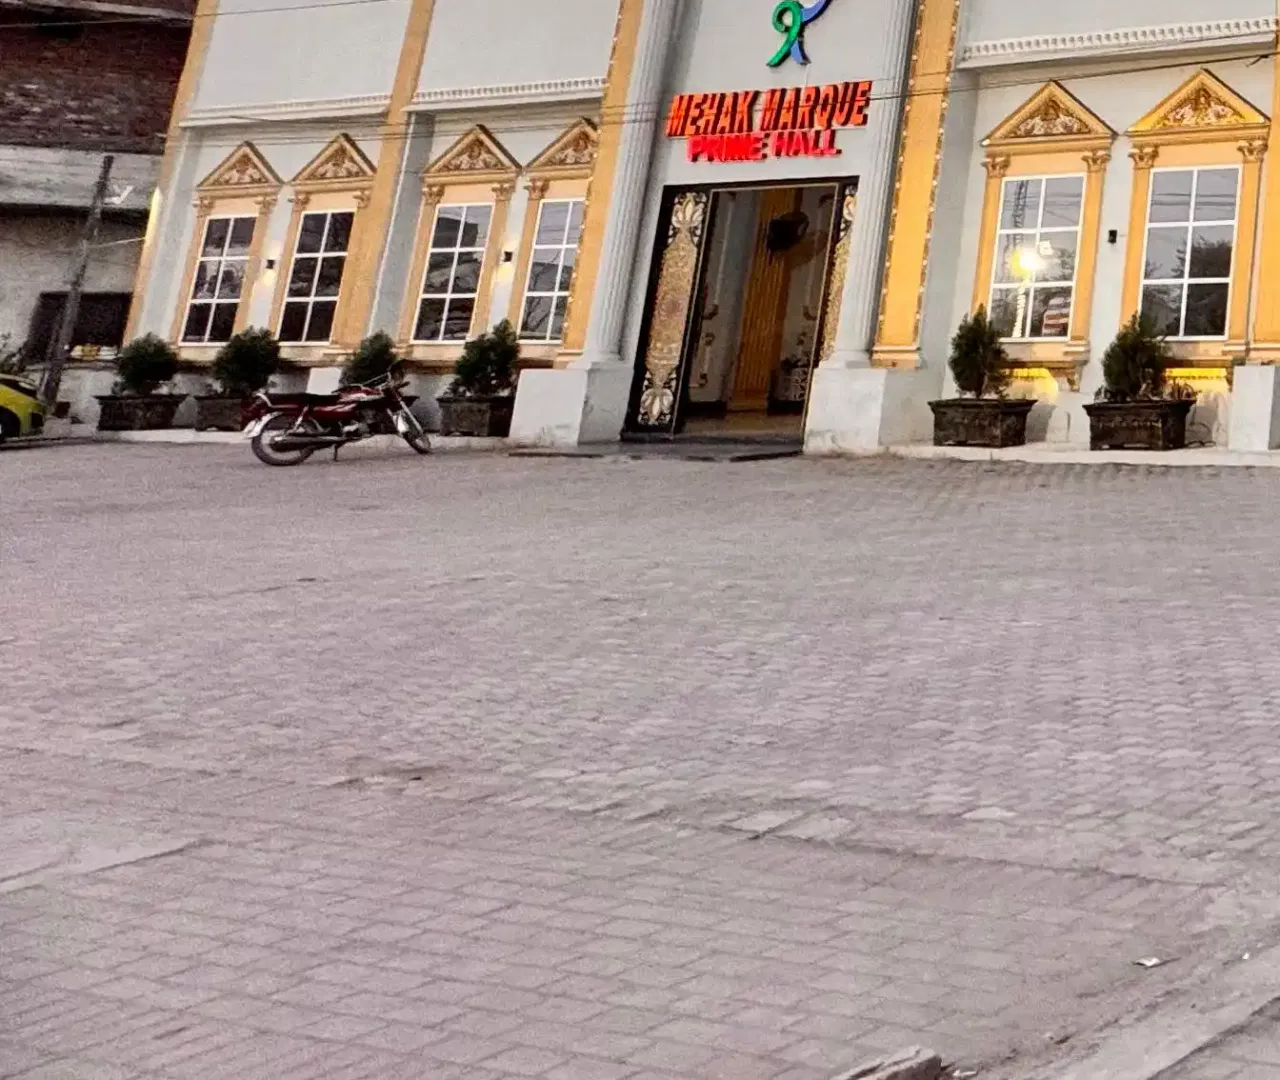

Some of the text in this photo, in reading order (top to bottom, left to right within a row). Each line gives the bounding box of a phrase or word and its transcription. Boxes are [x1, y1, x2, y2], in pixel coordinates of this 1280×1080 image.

[666, 80, 872, 137] MEHAK MARQUE
[687, 129, 842, 163] PRIME HALL
